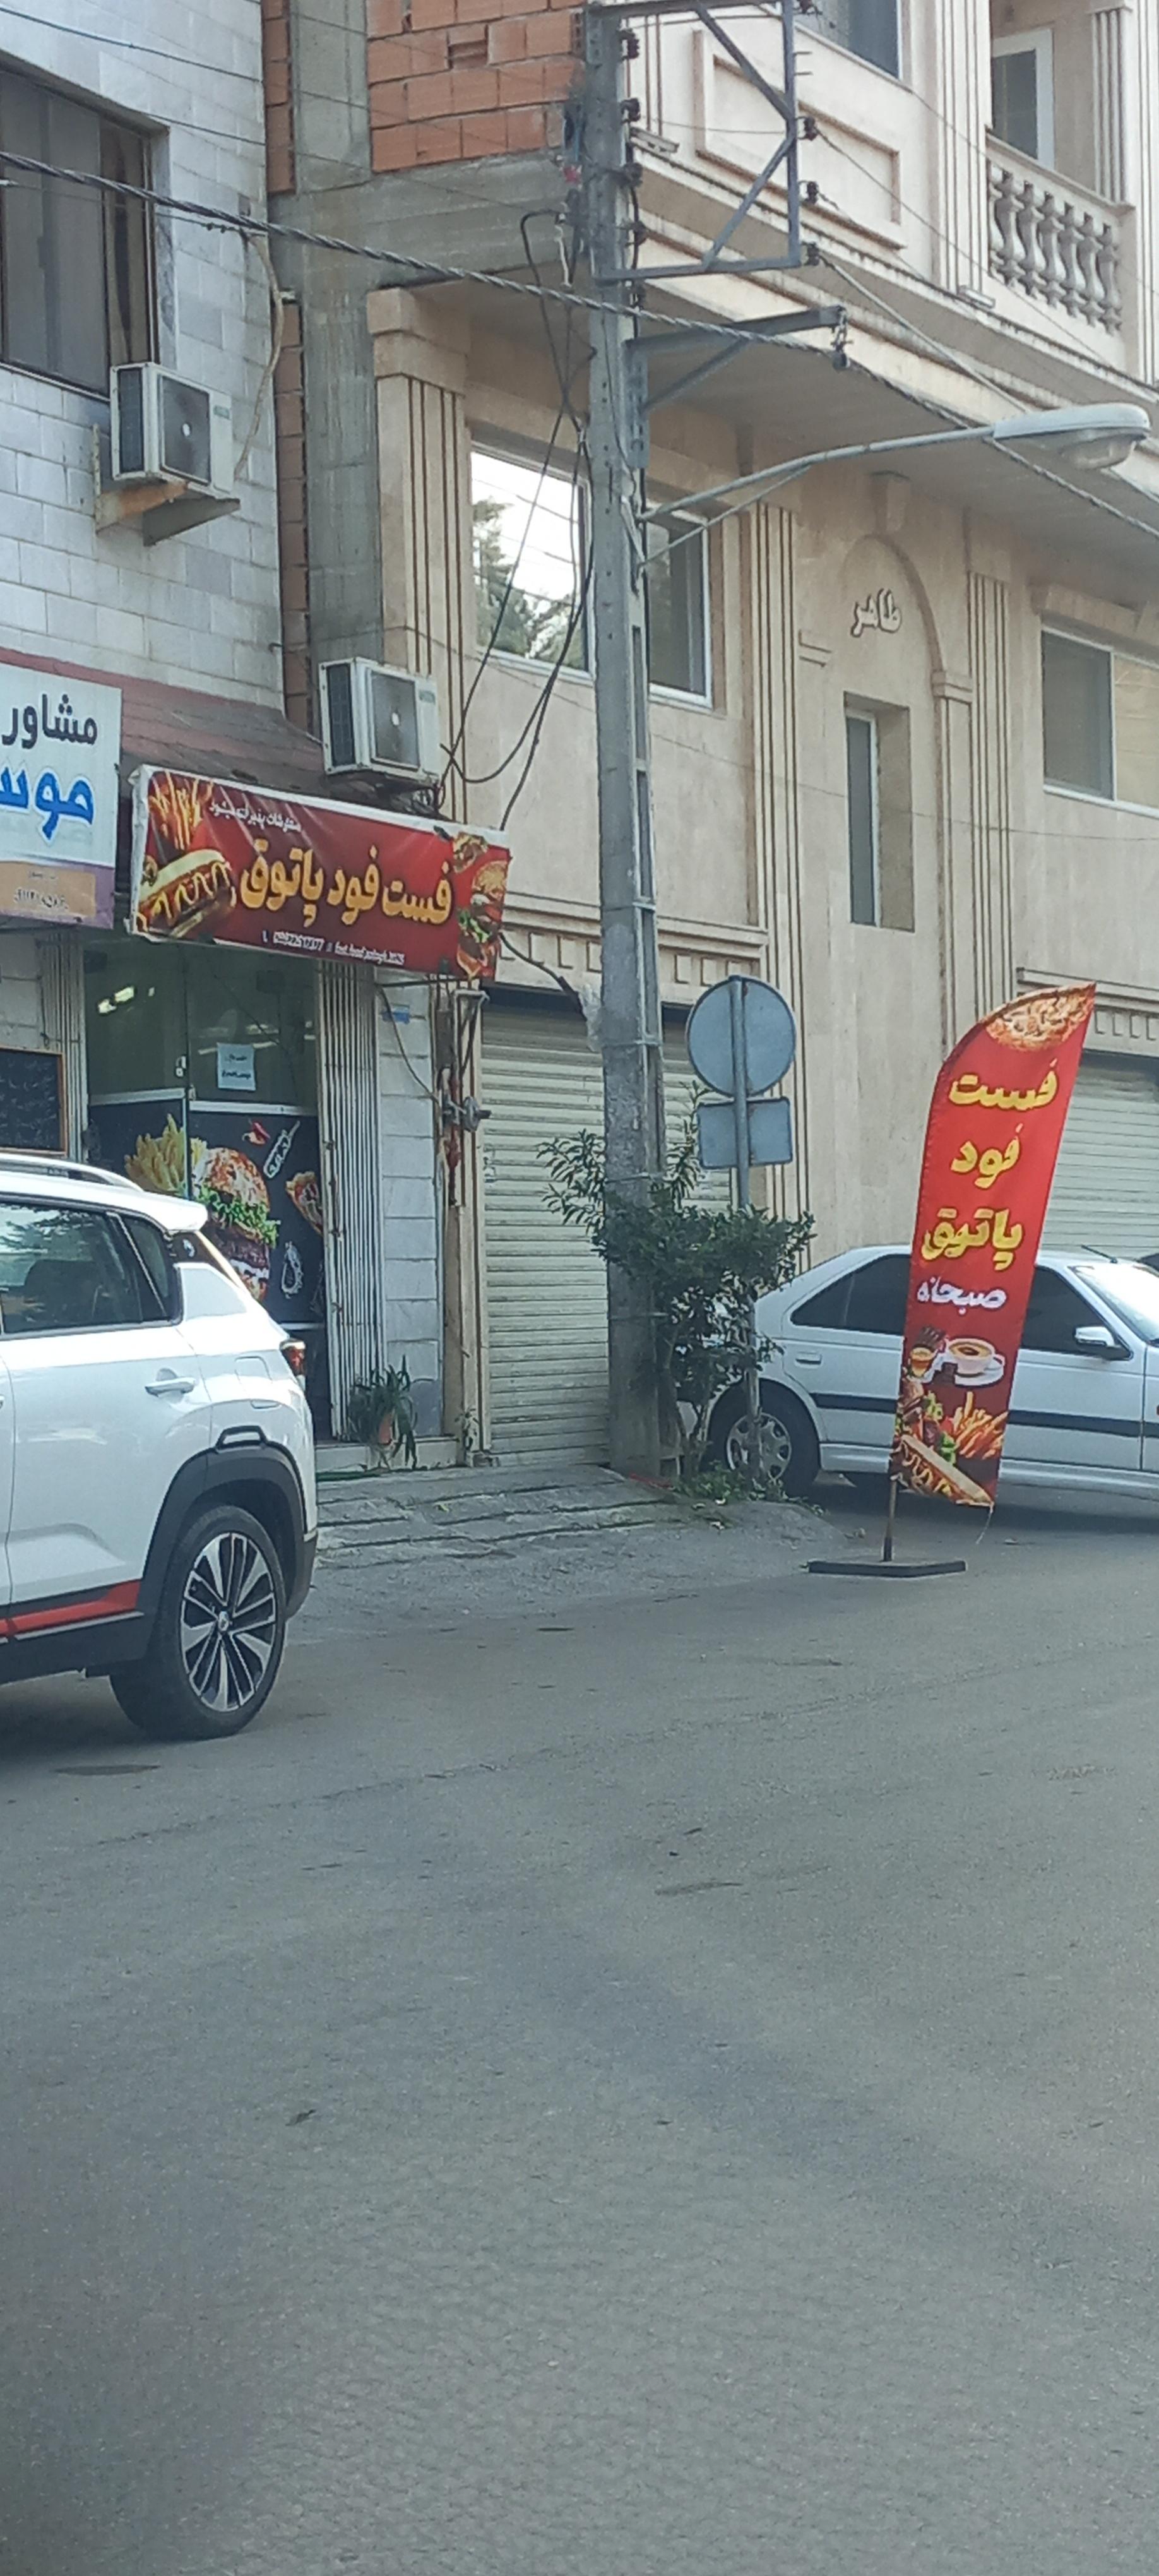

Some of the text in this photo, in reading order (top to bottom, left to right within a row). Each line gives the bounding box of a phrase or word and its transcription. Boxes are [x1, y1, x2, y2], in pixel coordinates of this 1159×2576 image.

[850, 588, 901, 638] طاهر
[241, 838, 452, 928] فست فود پاتوق
[949, 1058, 1057, 1111] فست
[950, 1123, 1024, 1190] فود
[921, 1207, 1023, 1272] پاتوق
[917, 1276, 1007, 1315] صبحانه
